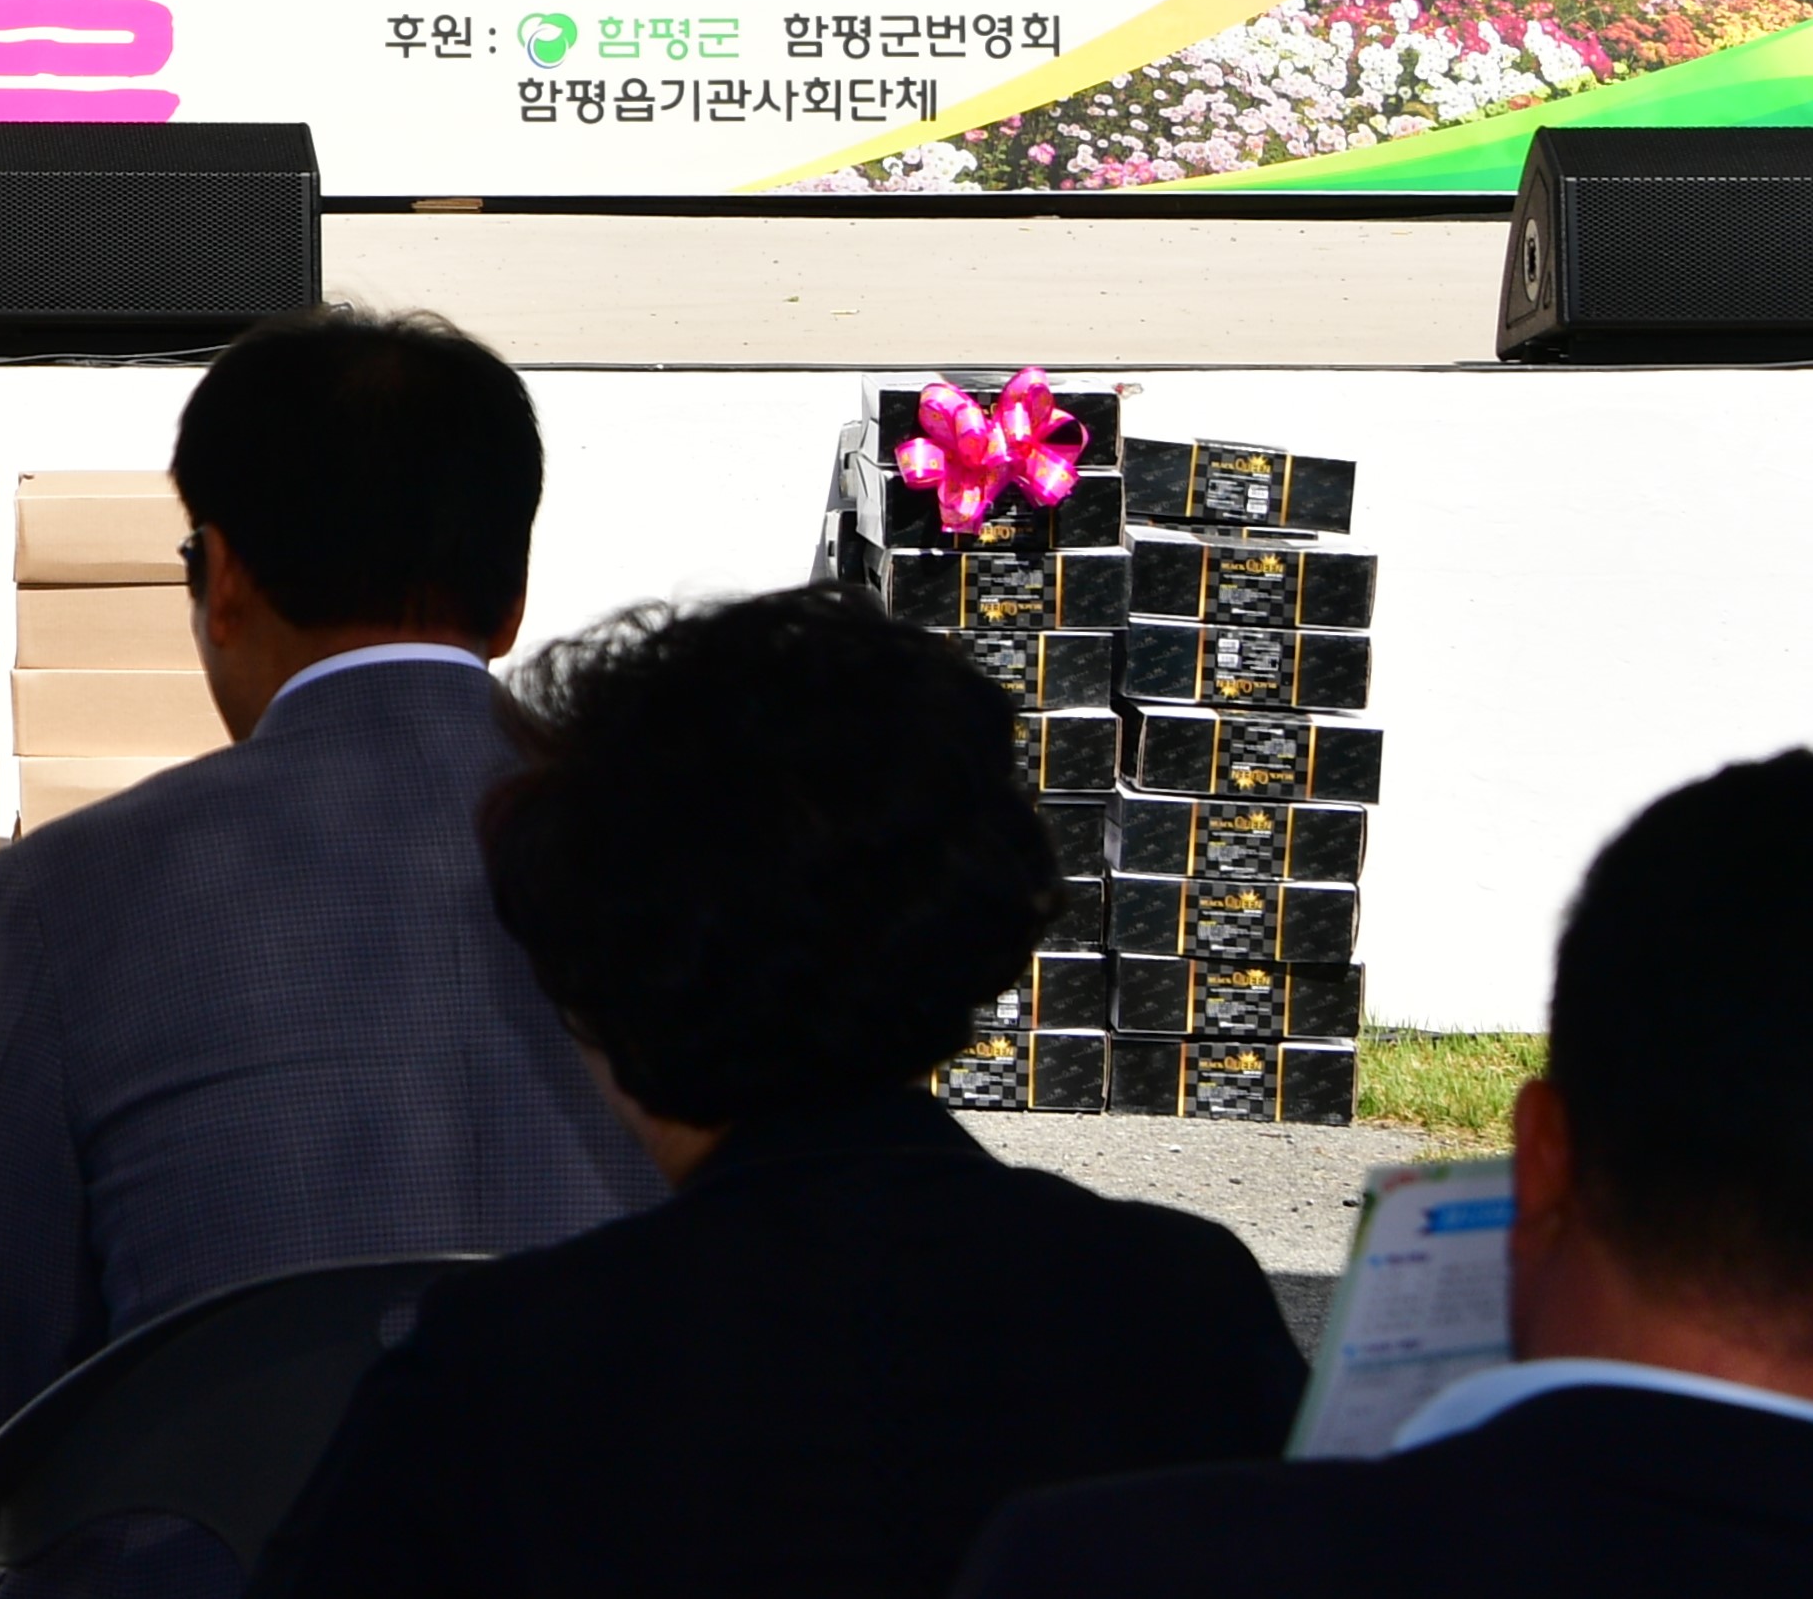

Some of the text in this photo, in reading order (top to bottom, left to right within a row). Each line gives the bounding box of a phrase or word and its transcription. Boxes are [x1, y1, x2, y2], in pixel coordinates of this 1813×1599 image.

[597, 14, 740, 61] 함평군
[784, 12, 1063, 61] 함평군번영회
[518, 77, 938, 124] 함평읍기관사회단체
[1234, 816, 1273, 831] QUEEN
[1225, 895, 1264, 910] QUEEN
[1232, 971, 1271, 986] QUEEN
[1224, 1056, 1263, 1071] QUEEN
